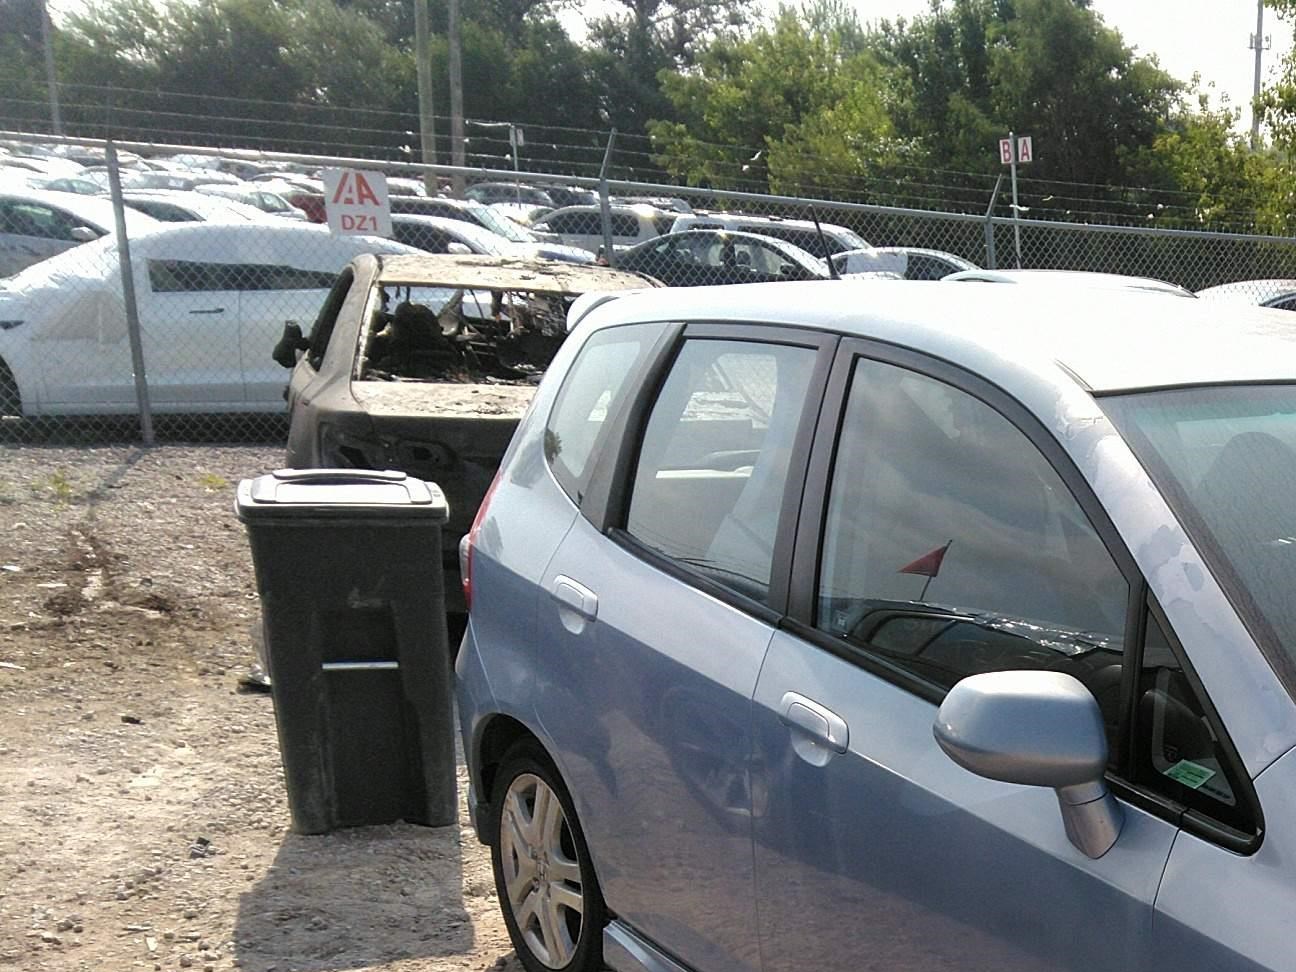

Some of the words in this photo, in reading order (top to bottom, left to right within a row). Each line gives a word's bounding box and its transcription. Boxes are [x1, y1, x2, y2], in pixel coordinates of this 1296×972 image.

[1002, 140, 1011, 162] B
[1020, 138, 1029, 161] A
[341, 214, 378, 231] DZ1
